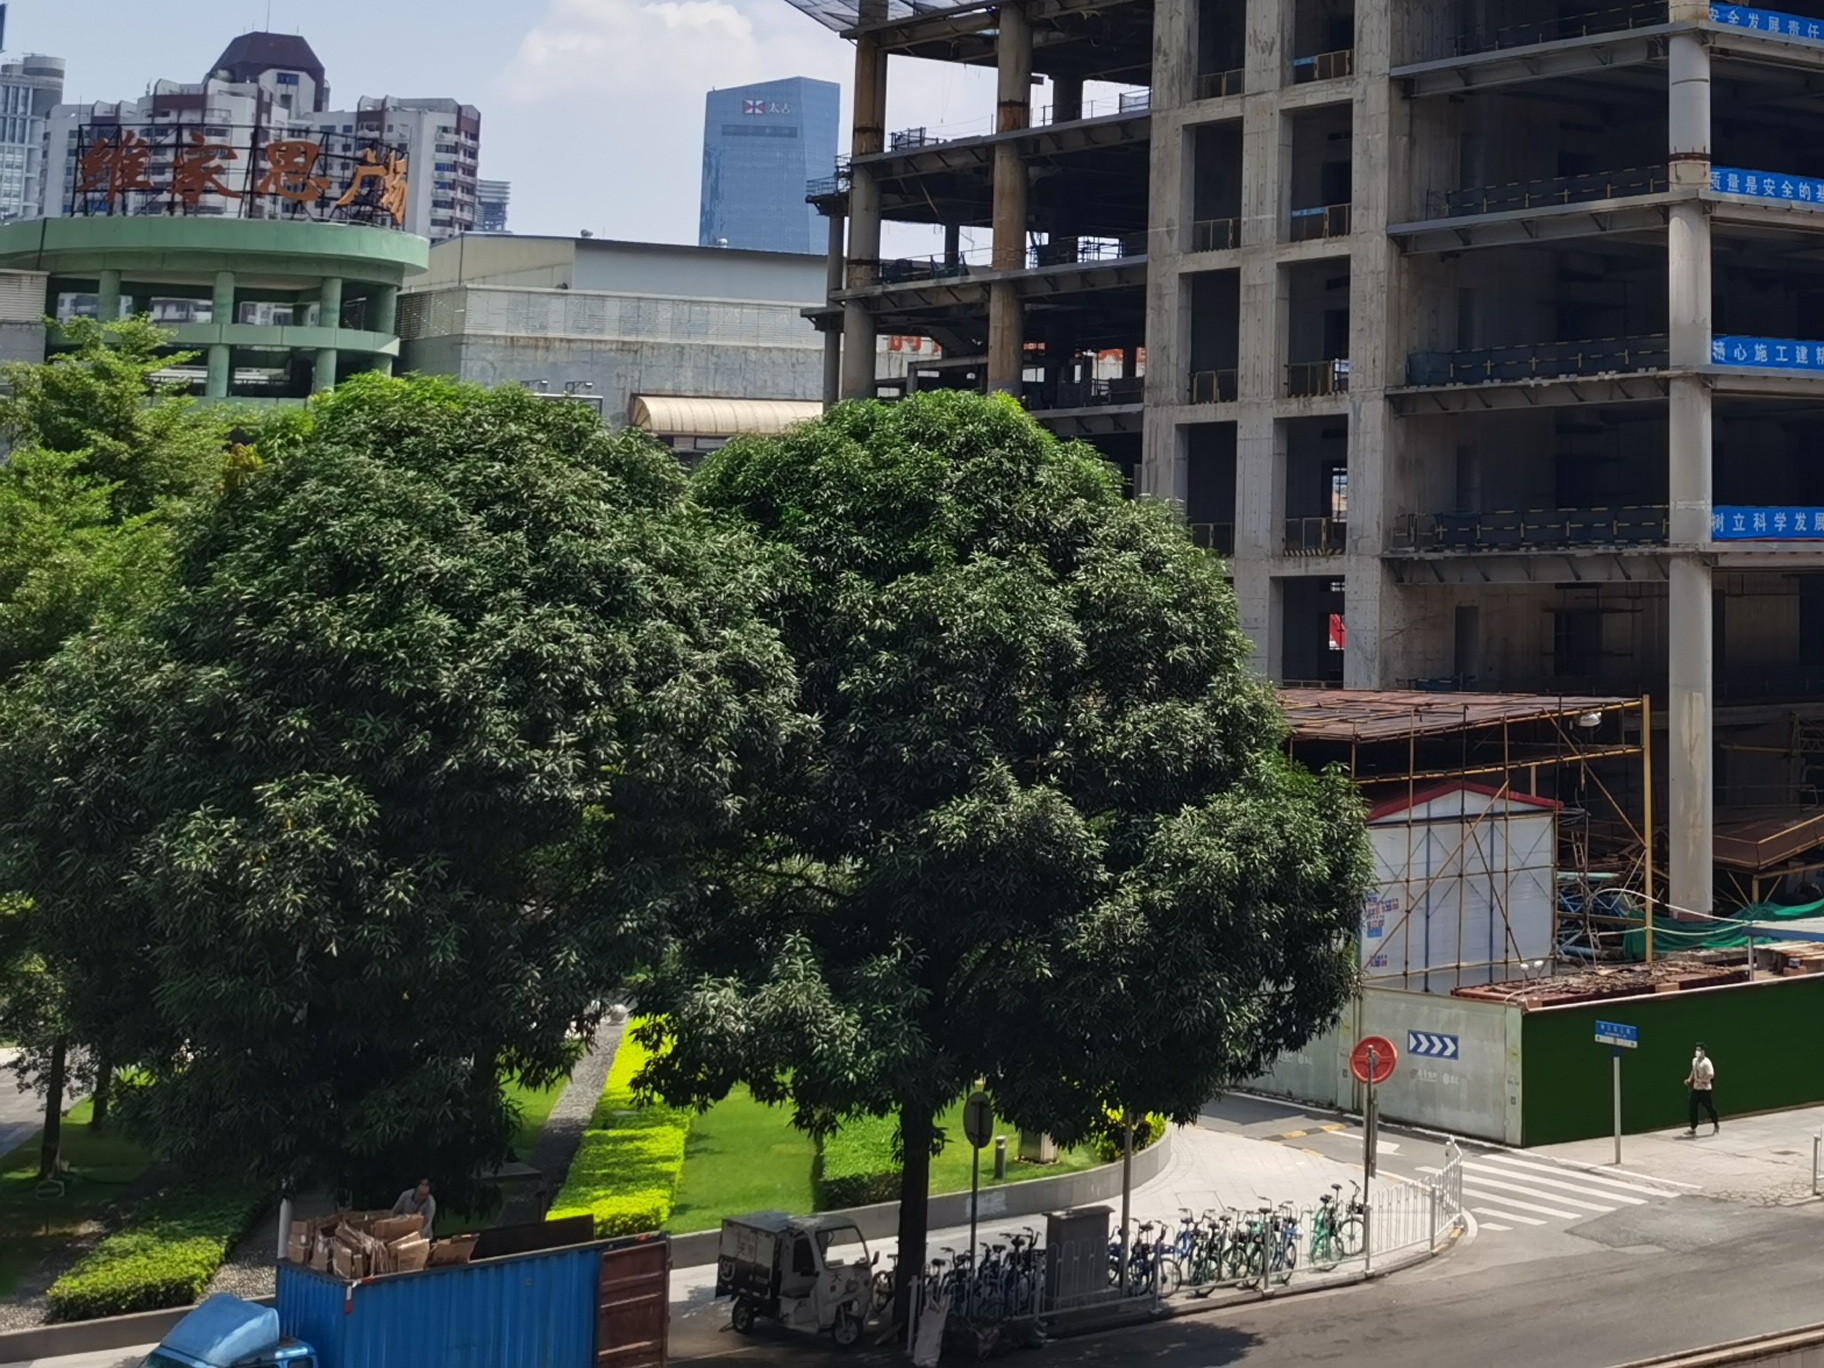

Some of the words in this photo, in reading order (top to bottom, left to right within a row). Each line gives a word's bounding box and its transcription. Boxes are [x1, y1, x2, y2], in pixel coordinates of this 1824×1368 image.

[769, 101, 791, 115] 太古
[77, 130, 407, 226] 维家思广场
